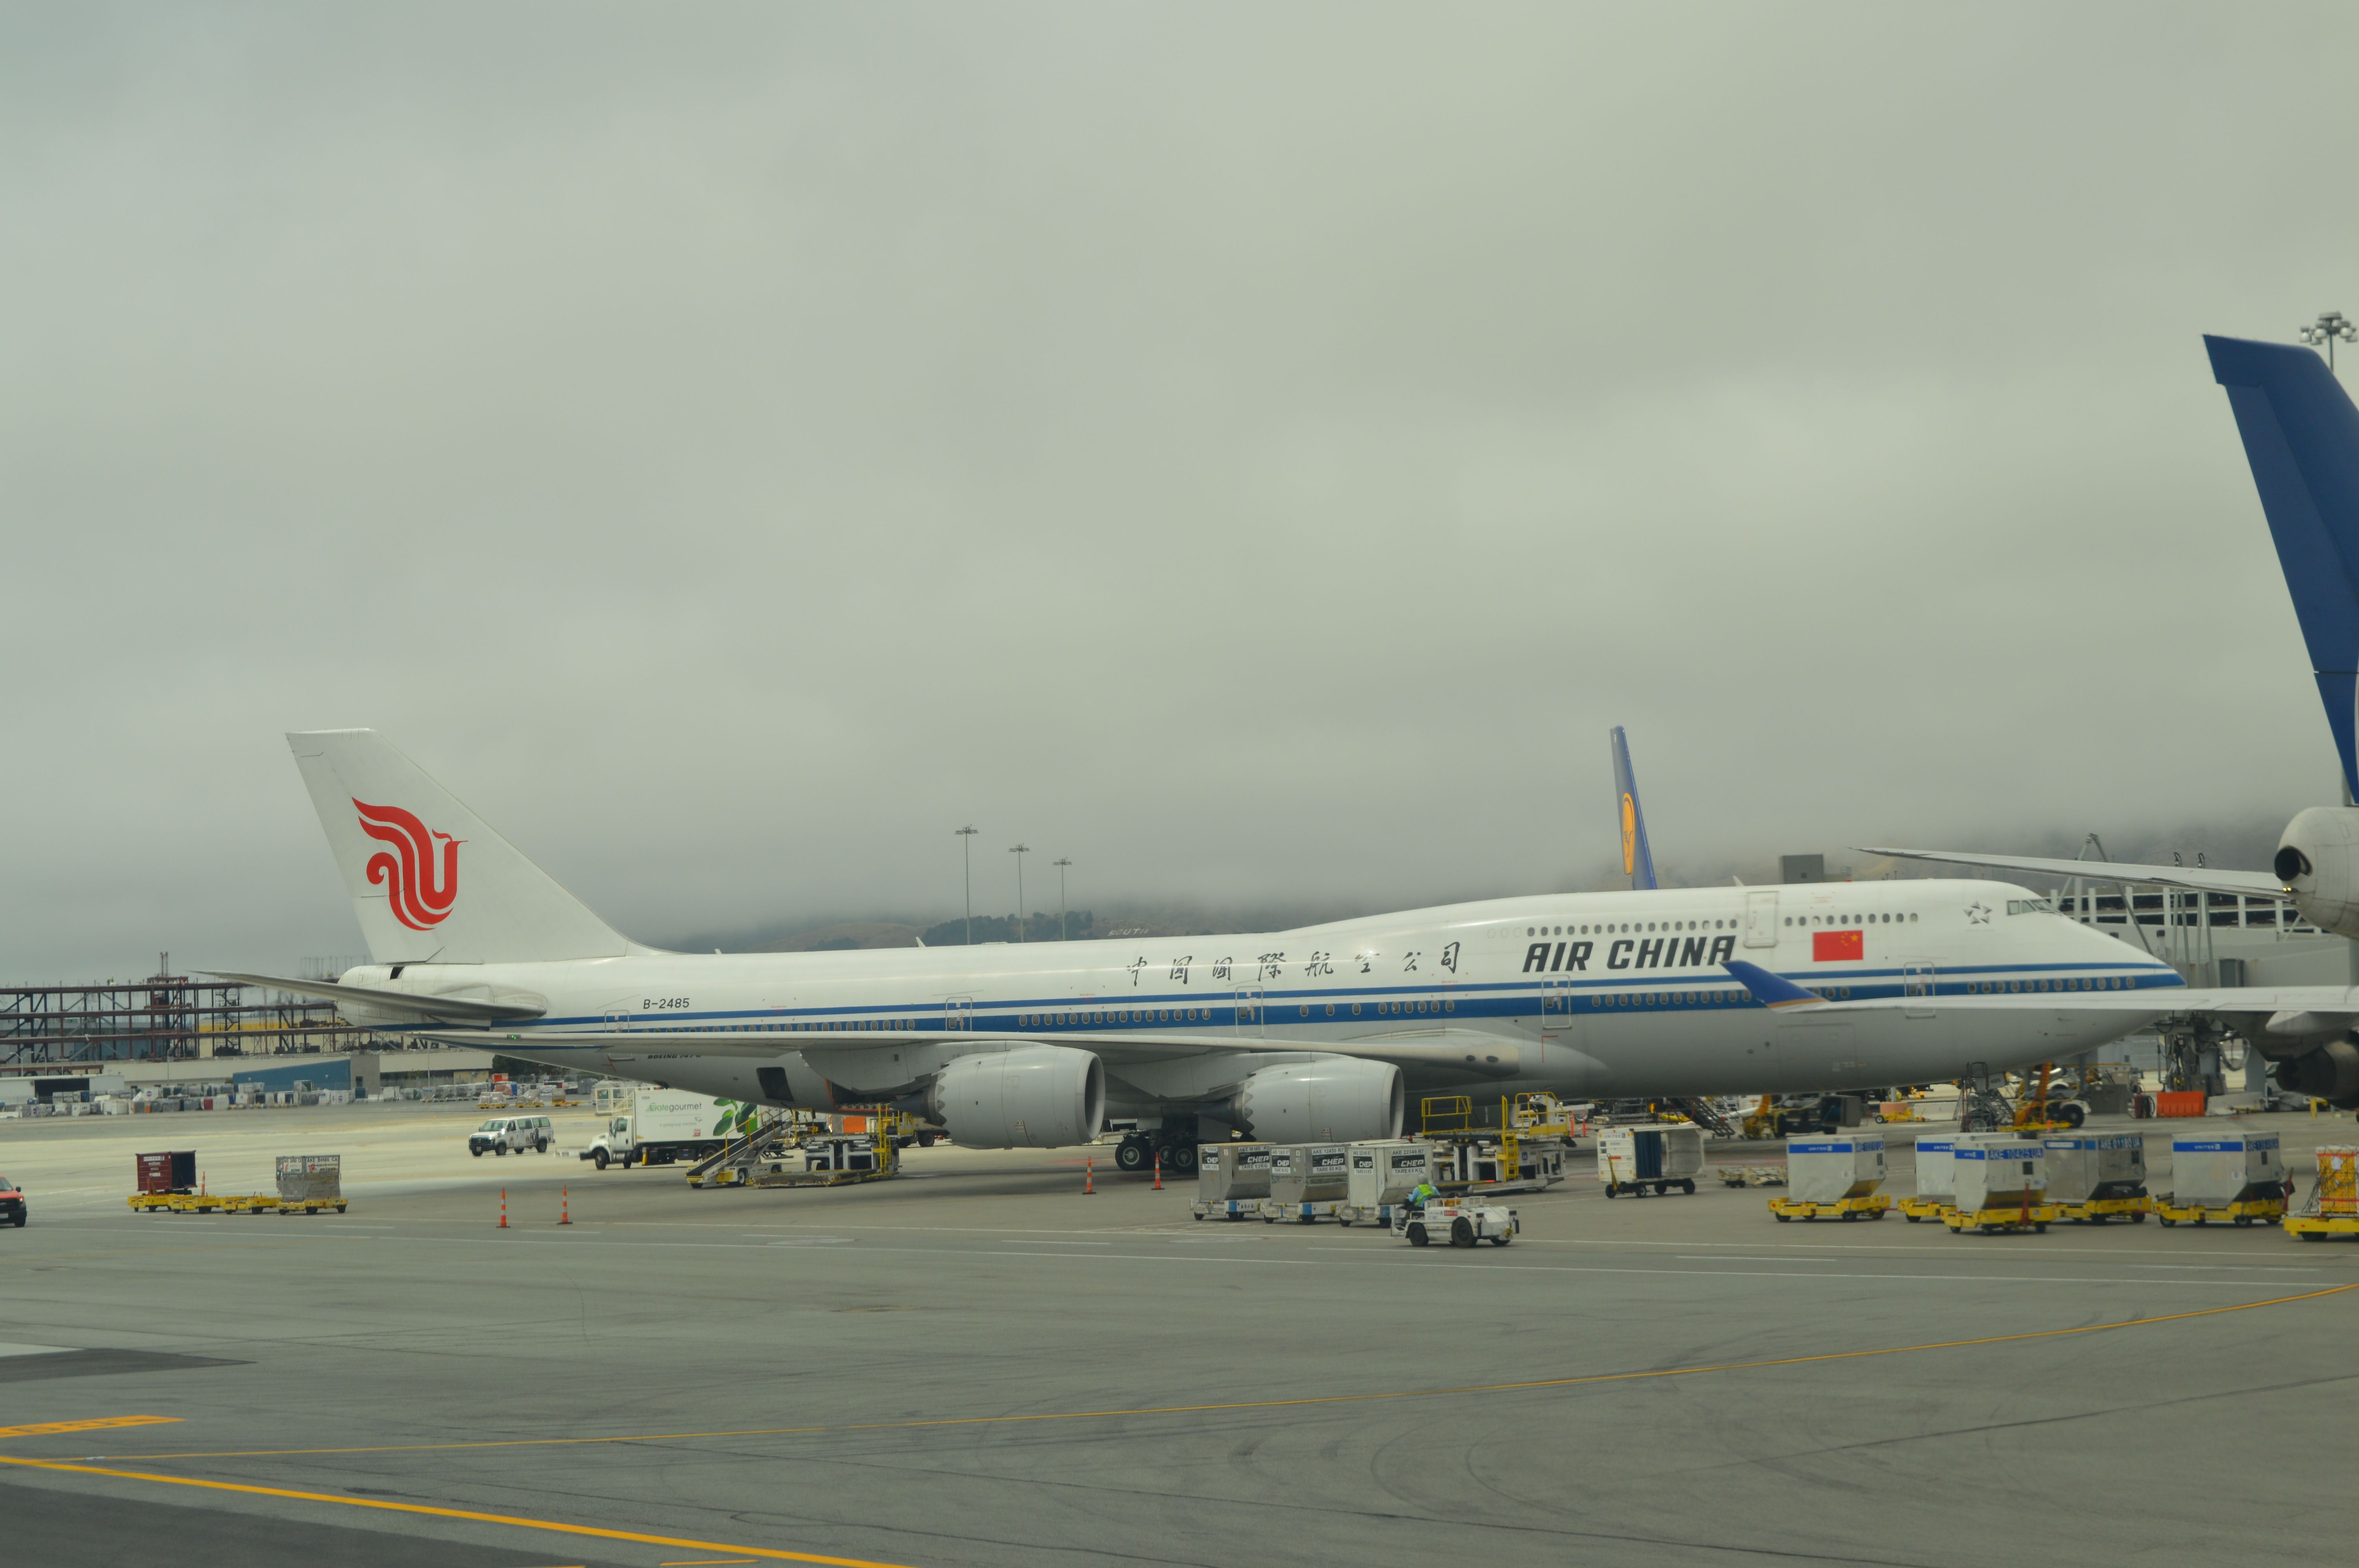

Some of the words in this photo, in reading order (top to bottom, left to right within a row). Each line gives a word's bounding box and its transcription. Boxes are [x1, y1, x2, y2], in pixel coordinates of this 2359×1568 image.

[1522, 941, 1594, 972] AIR
[1607, 935, 1736, 969] CHINA
[643, 998, 690, 1009] B-2485
[1990, 1149, 2004, 1159] AKE
[2006, 1149, 2029, 1158] 10425
[2031, 1148, 2043, 1157] UA
